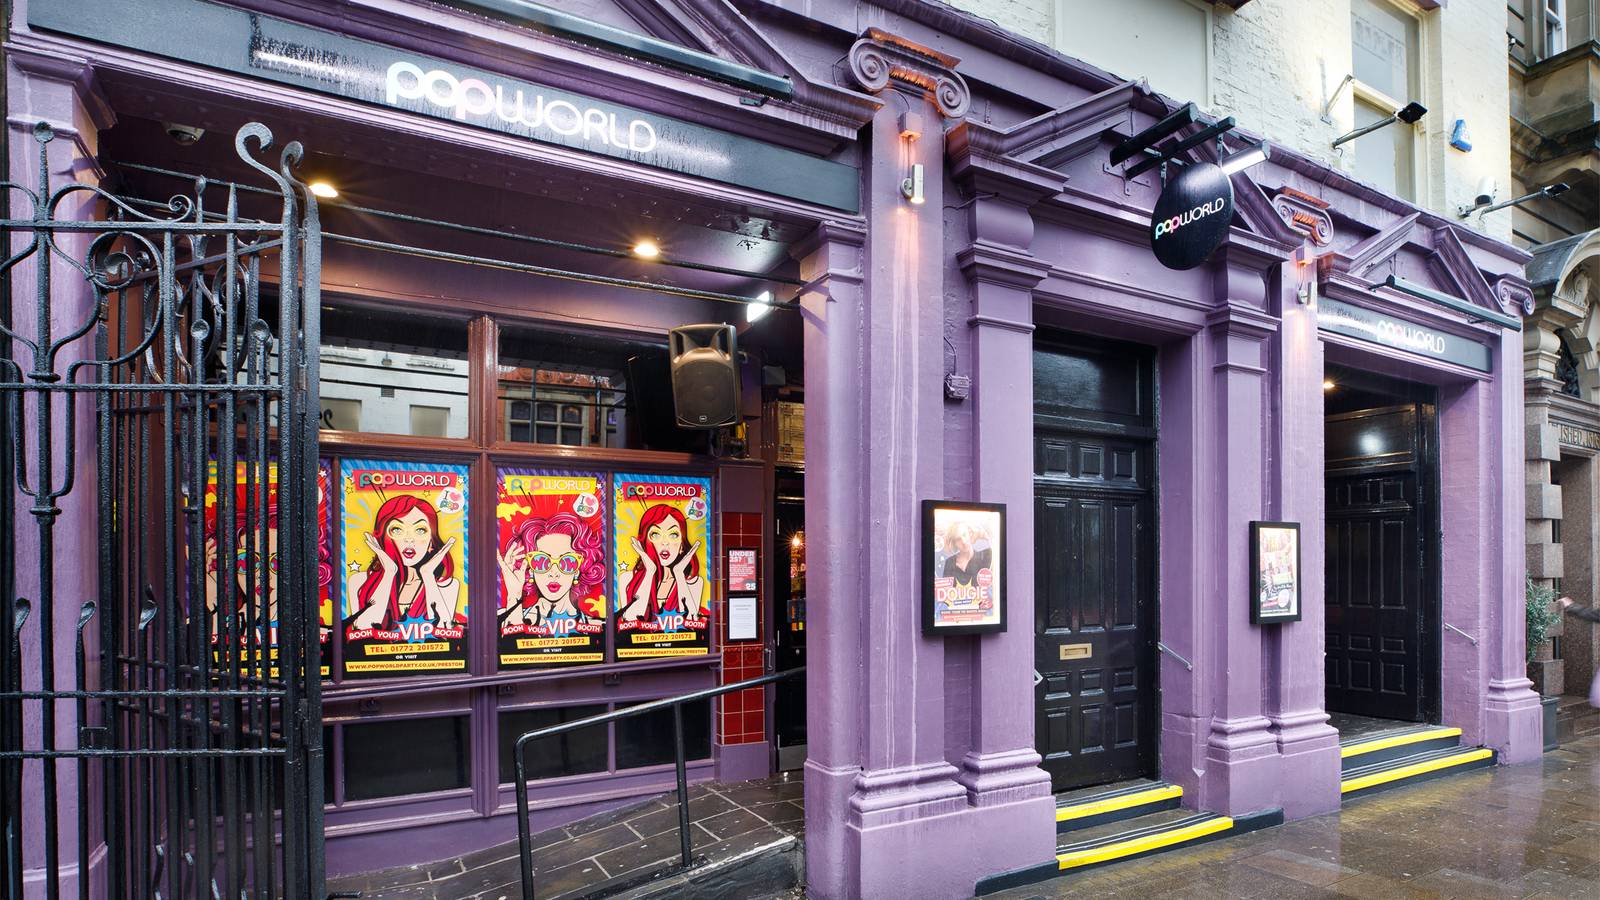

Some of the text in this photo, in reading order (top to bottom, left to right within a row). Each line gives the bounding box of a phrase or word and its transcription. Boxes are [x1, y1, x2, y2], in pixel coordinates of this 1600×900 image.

[937, 586, 989, 602] DOUGIE
[503, 625, 523, 634] BOOK
[547, 618, 576, 634] VIP
[577, 624, 600, 632] BOOTH
[619, 621, 637, 630] BOOK
[657, 615, 684, 630] VIP
[685, 620, 705, 628] BOOTH
[349, 622, 461, 640] BOOK YOUR VIP BOOTH
